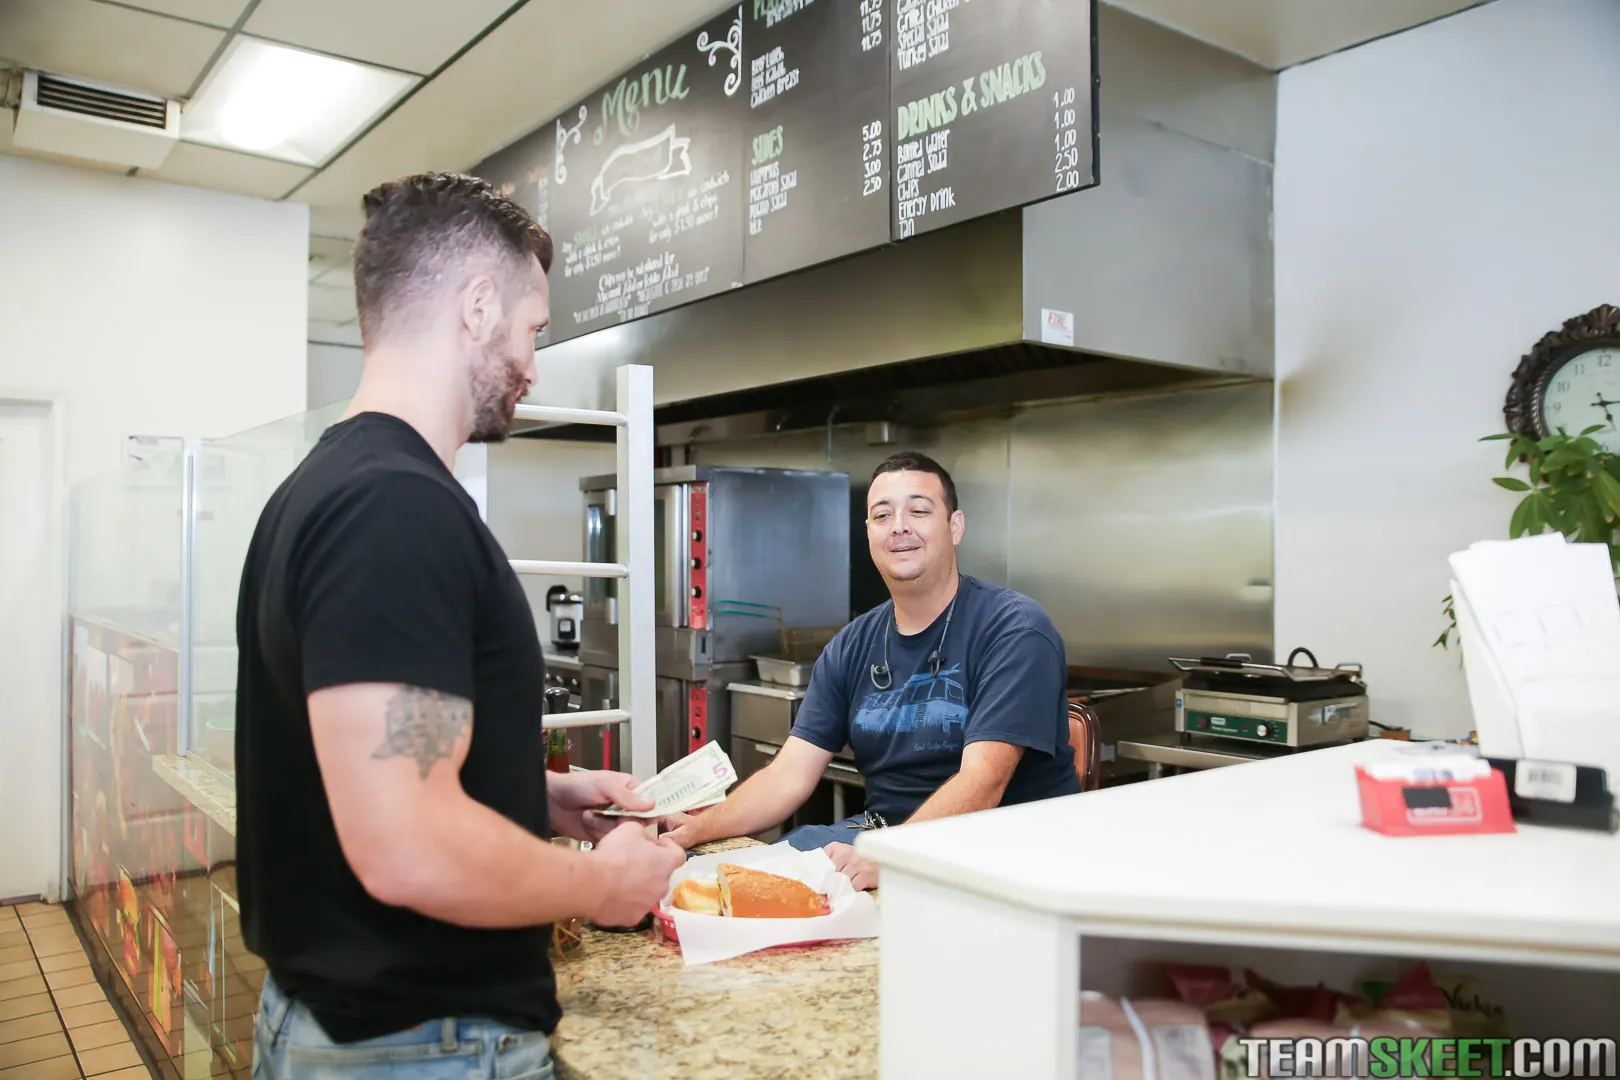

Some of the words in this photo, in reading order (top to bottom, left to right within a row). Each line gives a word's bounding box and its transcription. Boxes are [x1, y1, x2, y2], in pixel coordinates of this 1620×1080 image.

[862, 10, 882, 33] 11.75
[927, 12, 949, 39] Salad
[861, 29, 882, 51] 11.75
[897, 42, 927, 71] Turkey
[928, 31, 949, 57] Salad
[594, 64, 690, 146] Menu
[897, 85, 958, 140] DRINKS
[961, 77, 977, 116] &
[980, 51, 1046, 108] SNACKS
[1053, 87, 1075, 108] 1.00
[862, 120, 882, 141] 5.00
[1054, 109, 1075, 130] 1.00
[752, 125, 783, 165] SIDES
[863, 139, 882, 161] 2.75
[1054, 129, 1077, 152] 1.00
[864, 159, 882, 178] 3.00
[1055, 148, 1078, 174] 2.50
[863, 176, 882, 196] 2.50
[1056, 170, 1079, 193] 2.00
[898, 195, 927, 221] Energy
[930, 187, 956, 212] Drink
[1574, 363, 1586, 375] 11
[1598, 354, 1612, 367] 12
[1557, 381, 1571, 393] 10
[1553, 403, 1561, 413] 9
